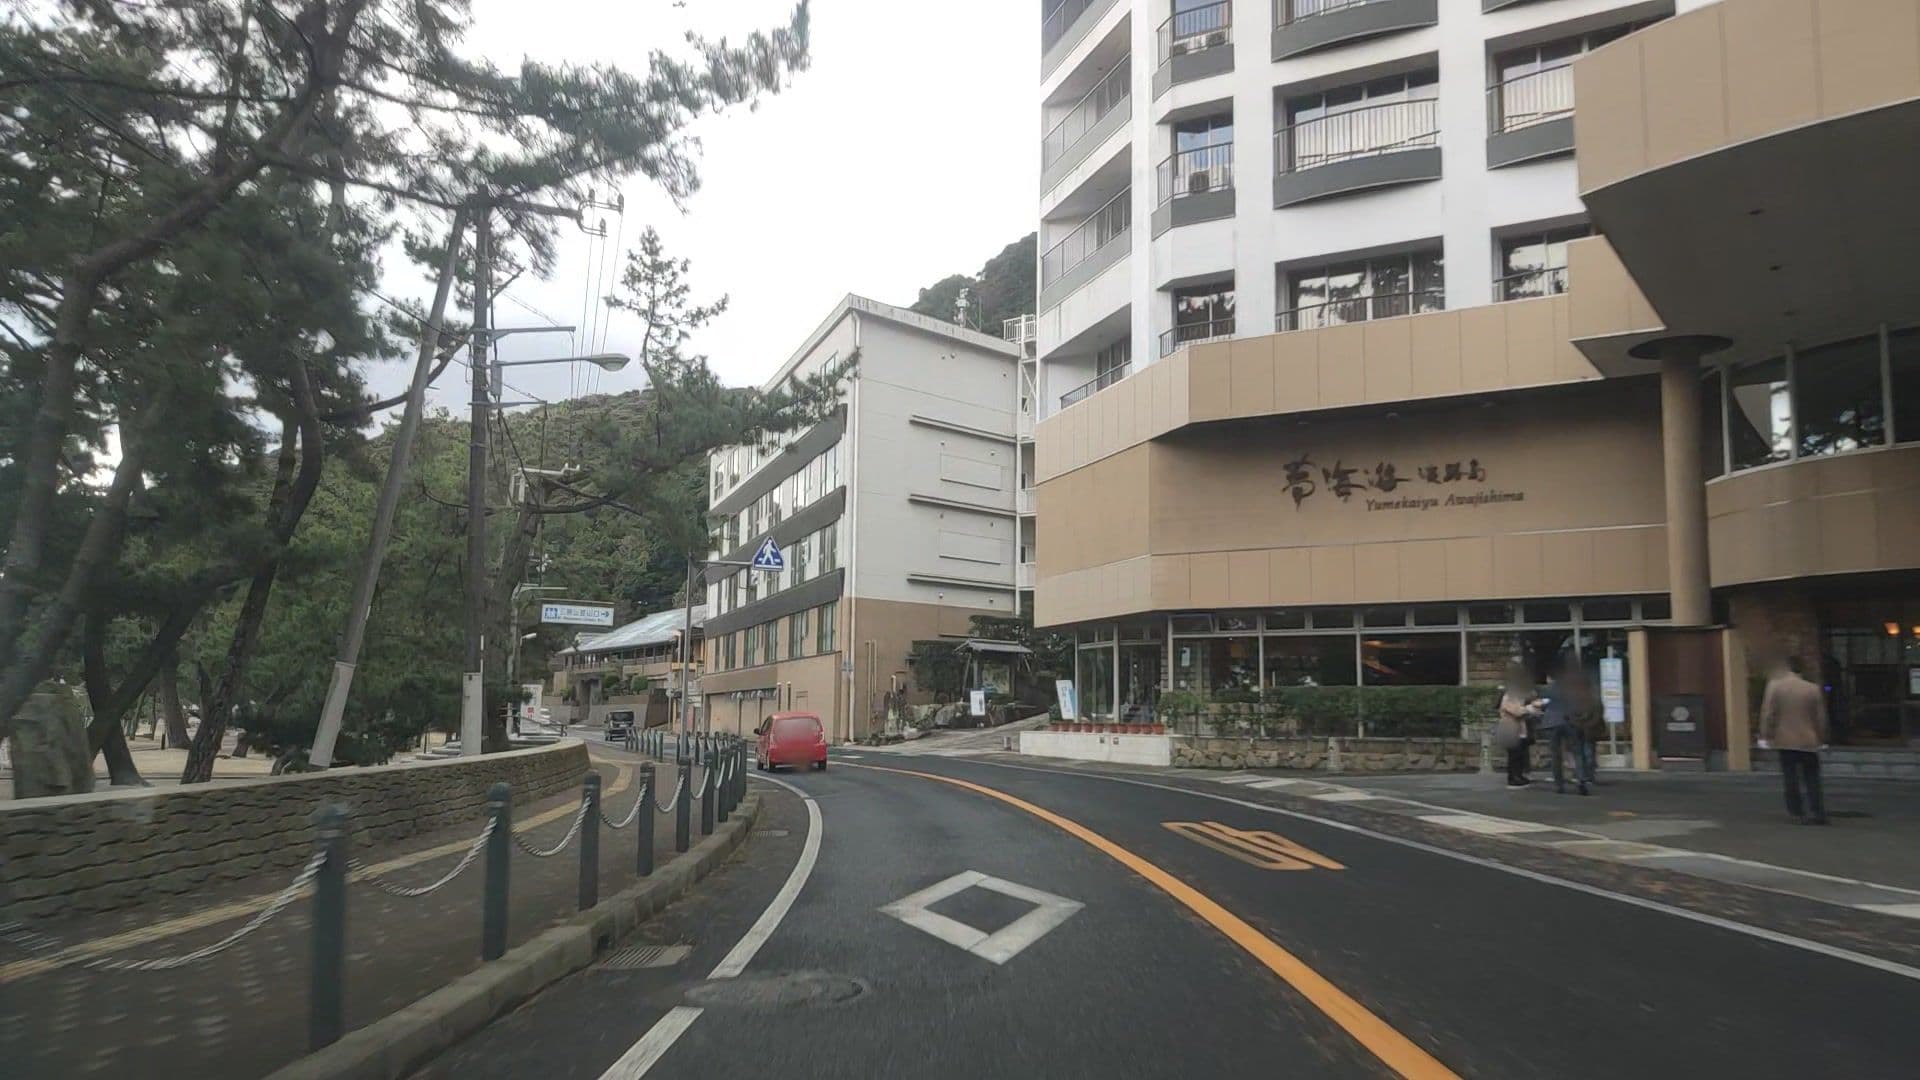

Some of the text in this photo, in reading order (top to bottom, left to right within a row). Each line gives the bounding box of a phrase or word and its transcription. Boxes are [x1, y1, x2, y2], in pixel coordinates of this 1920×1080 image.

[1282, 453, 1486, 509] 夢海遊 淡路島
[1366, 489, 1524, 512] Yumekaiyu Awajishima
